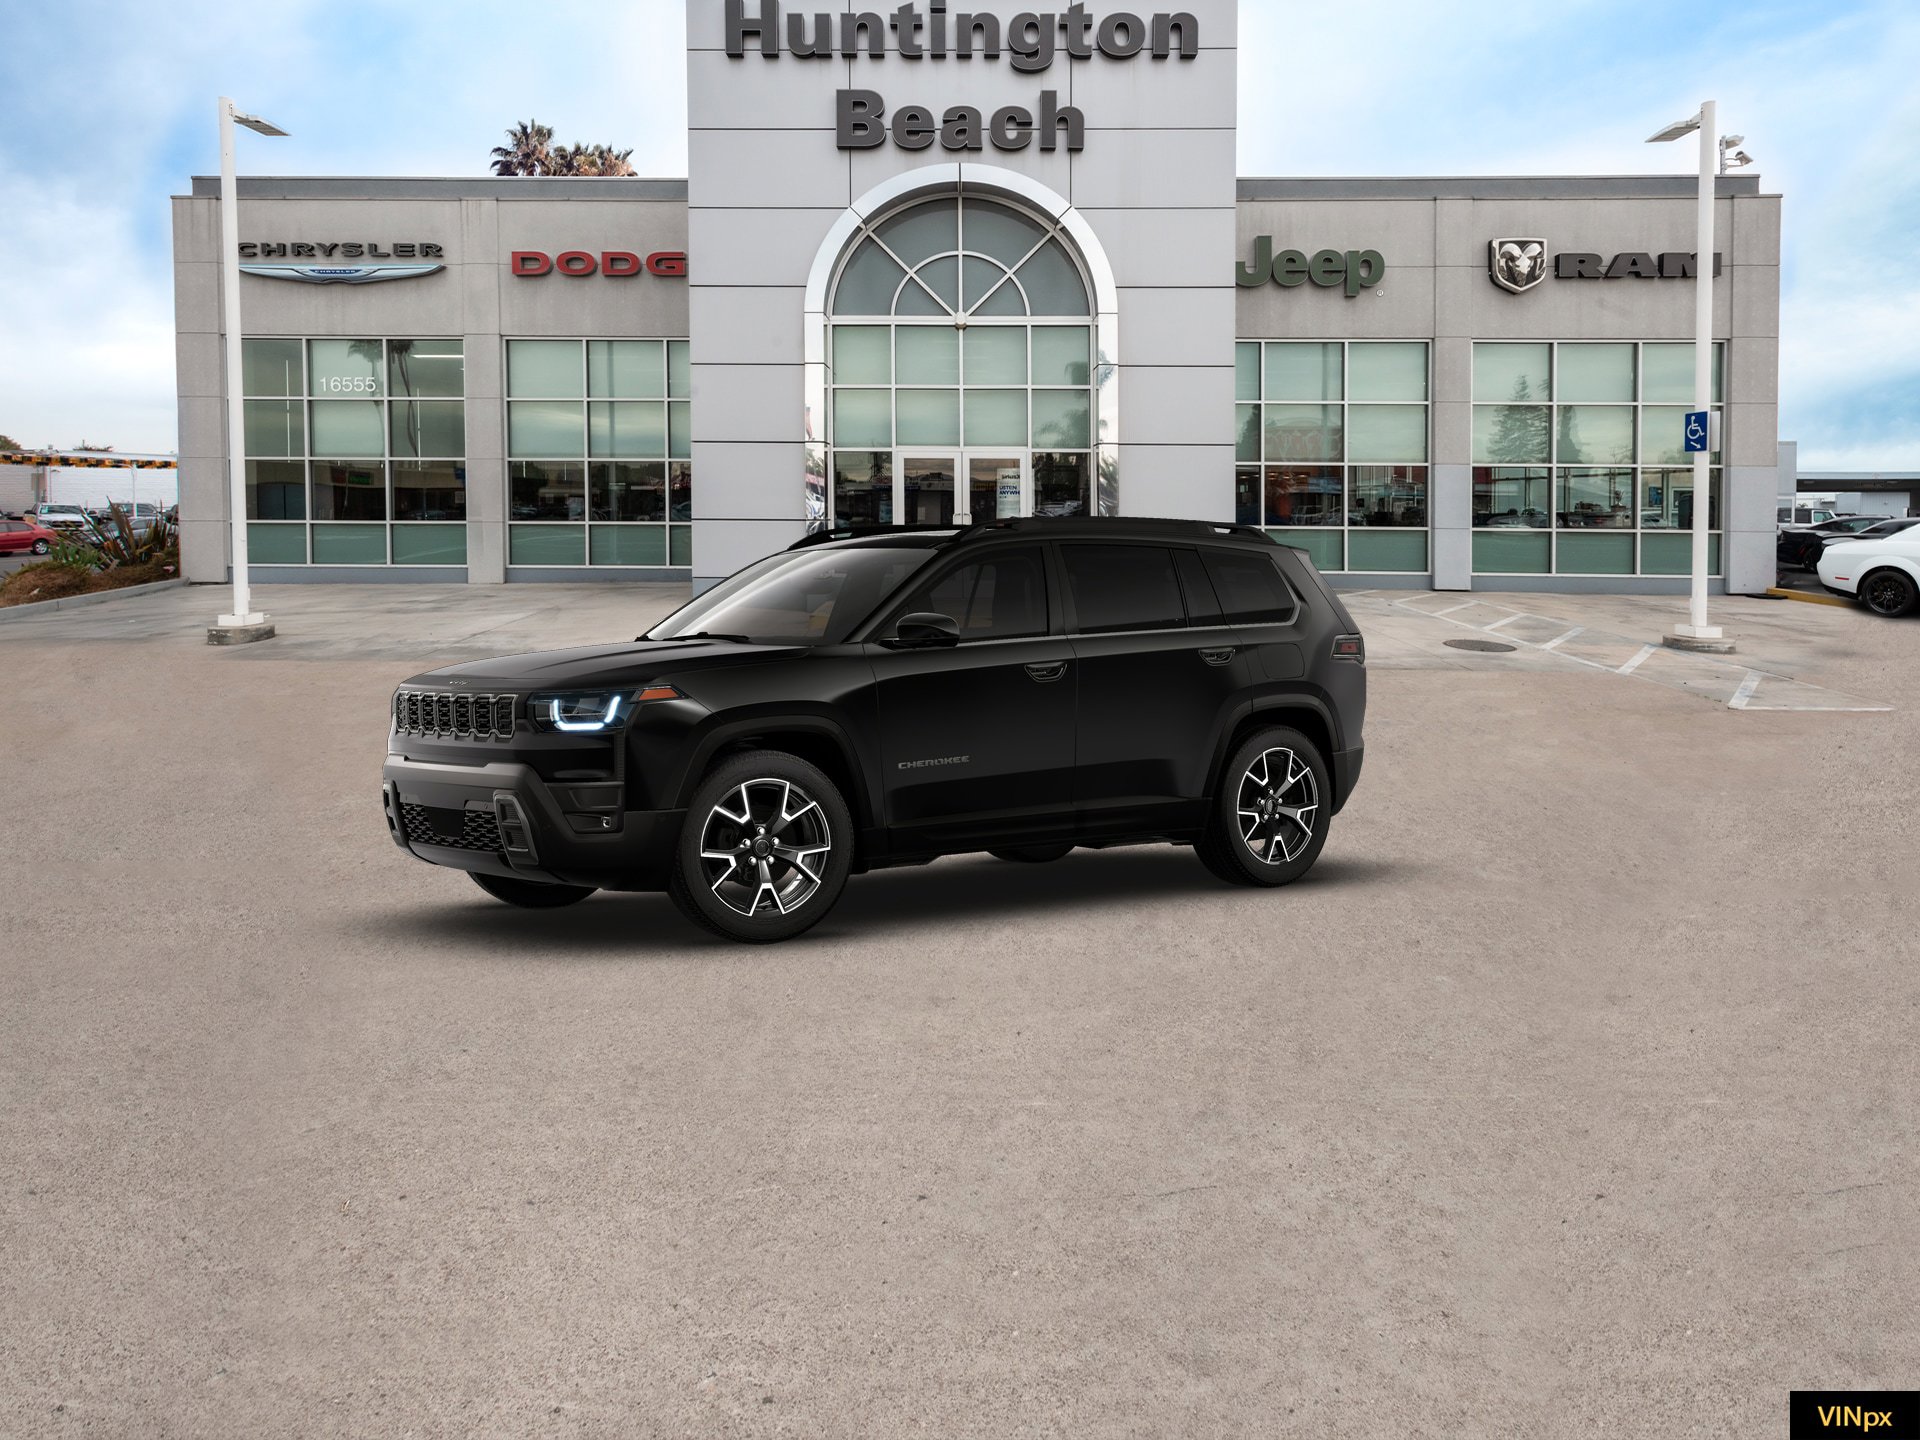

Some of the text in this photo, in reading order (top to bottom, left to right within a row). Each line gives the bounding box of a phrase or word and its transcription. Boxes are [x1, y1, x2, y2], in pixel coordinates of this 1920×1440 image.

[724, 0, 1199, 73] Huntington
[836, 88, 1085, 151] Beach
[238, 242, 444, 258] CHRYSLER
[1235, 235, 1386, 298] Jeep
[320, 376, 377, 392] 16555
[898, 755, 970, 770] CHEROKEE
